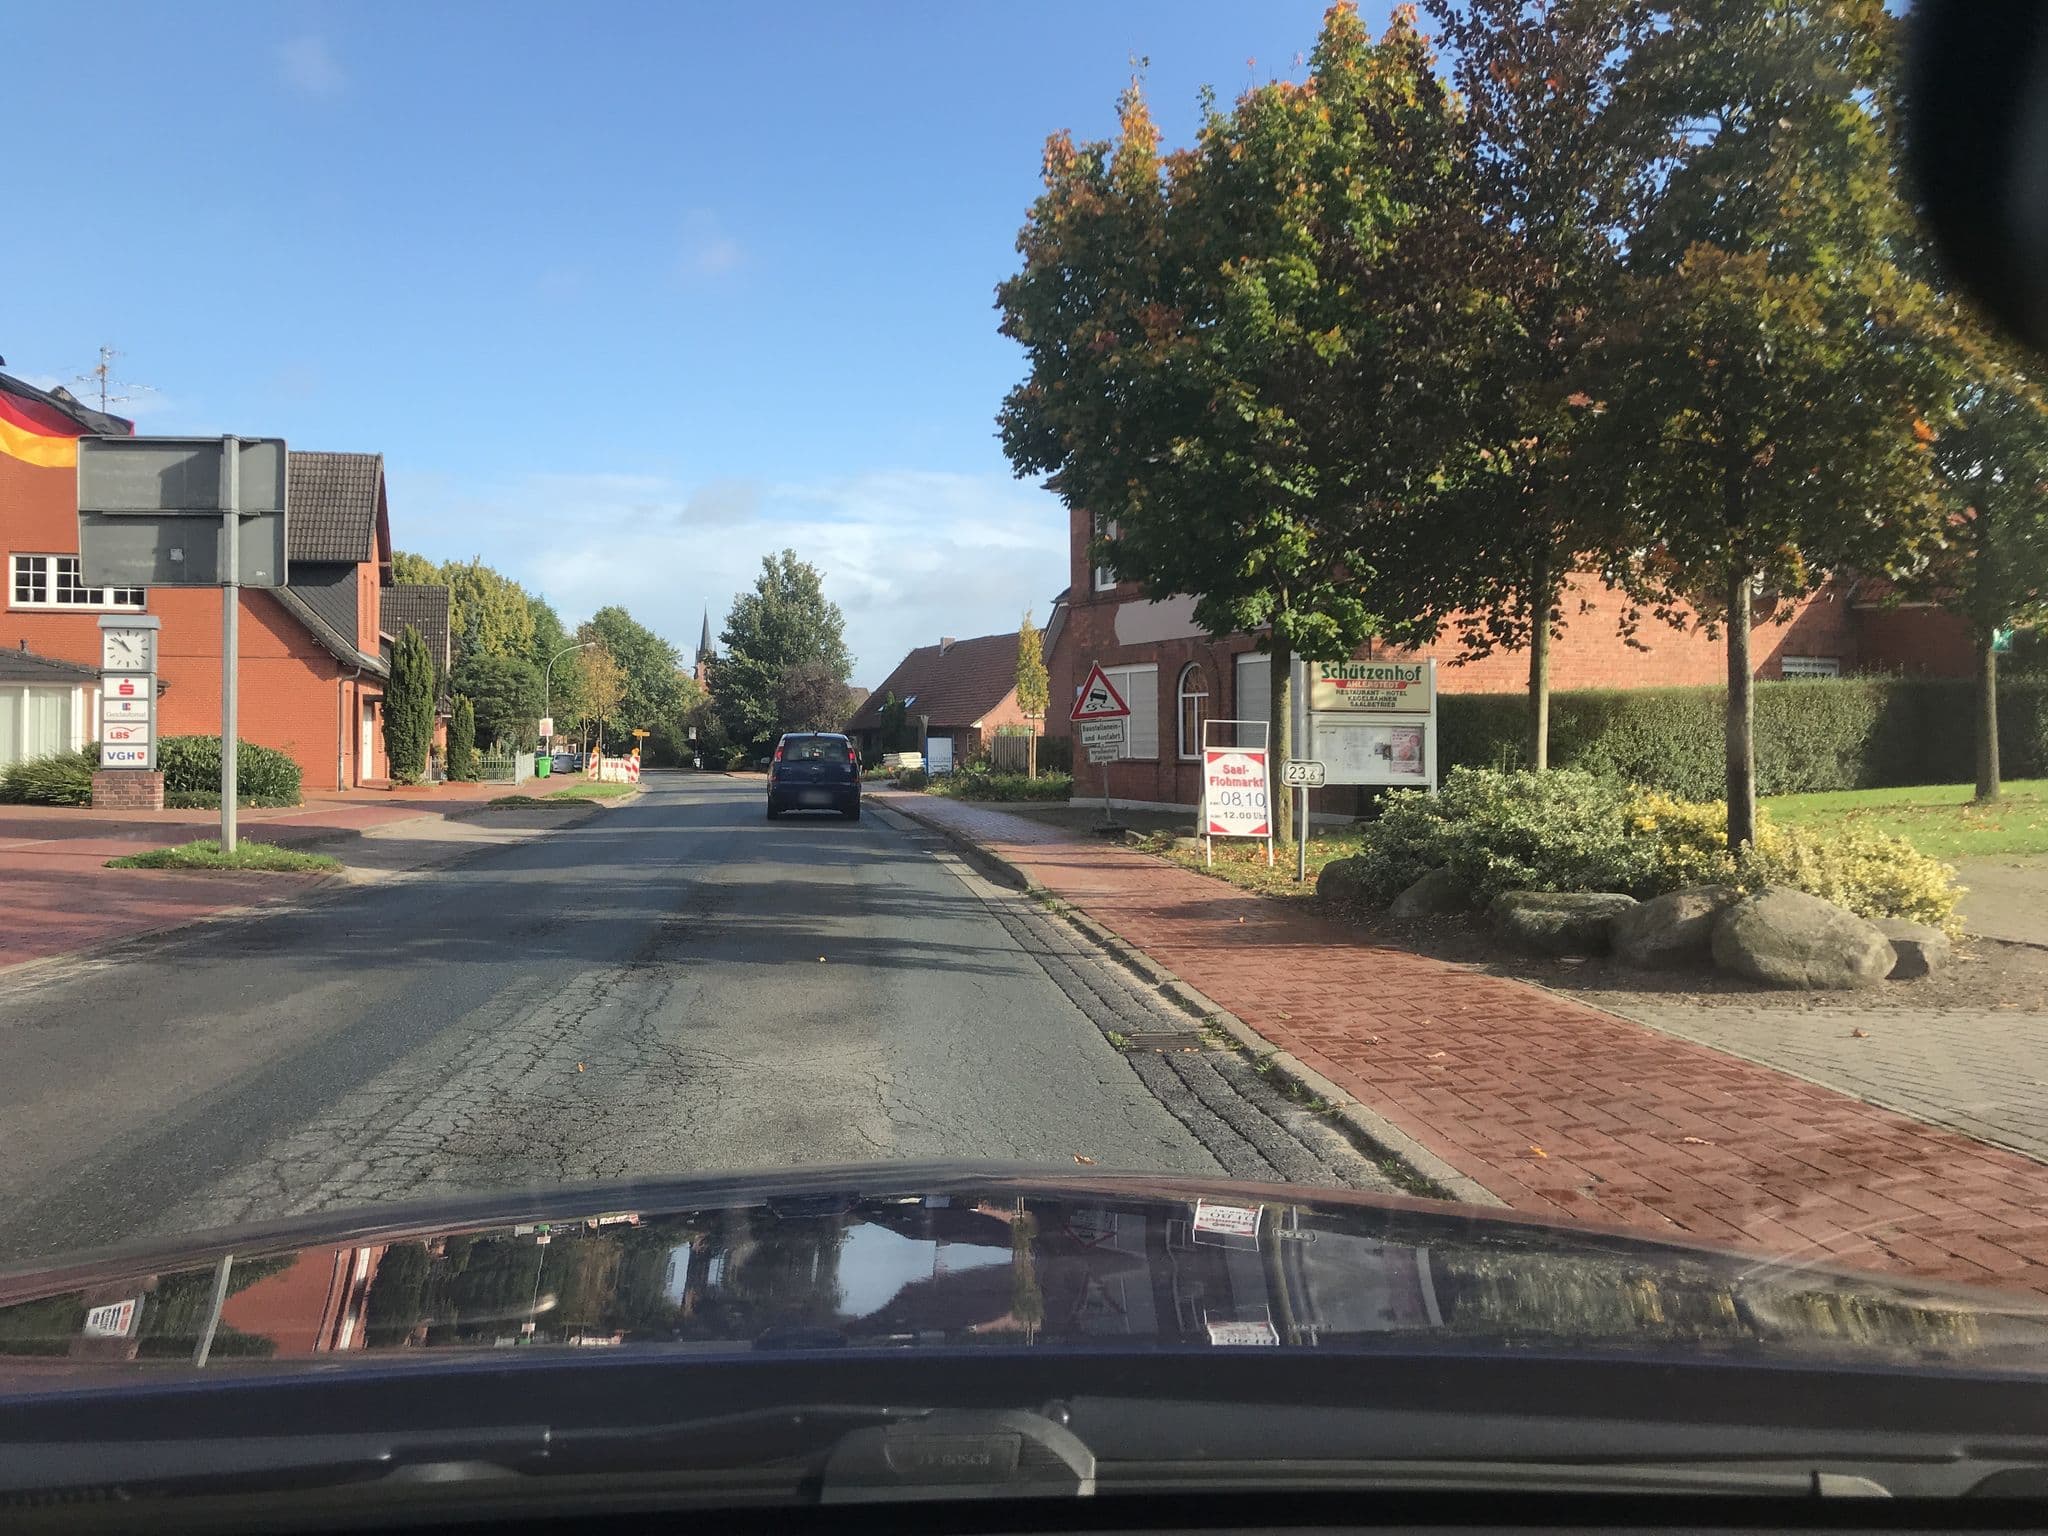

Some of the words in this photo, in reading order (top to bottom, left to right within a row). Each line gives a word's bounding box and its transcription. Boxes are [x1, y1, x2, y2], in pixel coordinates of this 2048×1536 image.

[1321, 664, 1421, 681] Schützenhof
[1346, 681, 1399, 689] AHLERSTEDT
[110, 731, 130, 739] LBS
[107, 751, 135, 760] VGH
[1223, 765, 1249, 775] Saal-
[1209, 776, 1265, 788] Flohmarkt
[1223, 811, 1252, 820] 12.00
